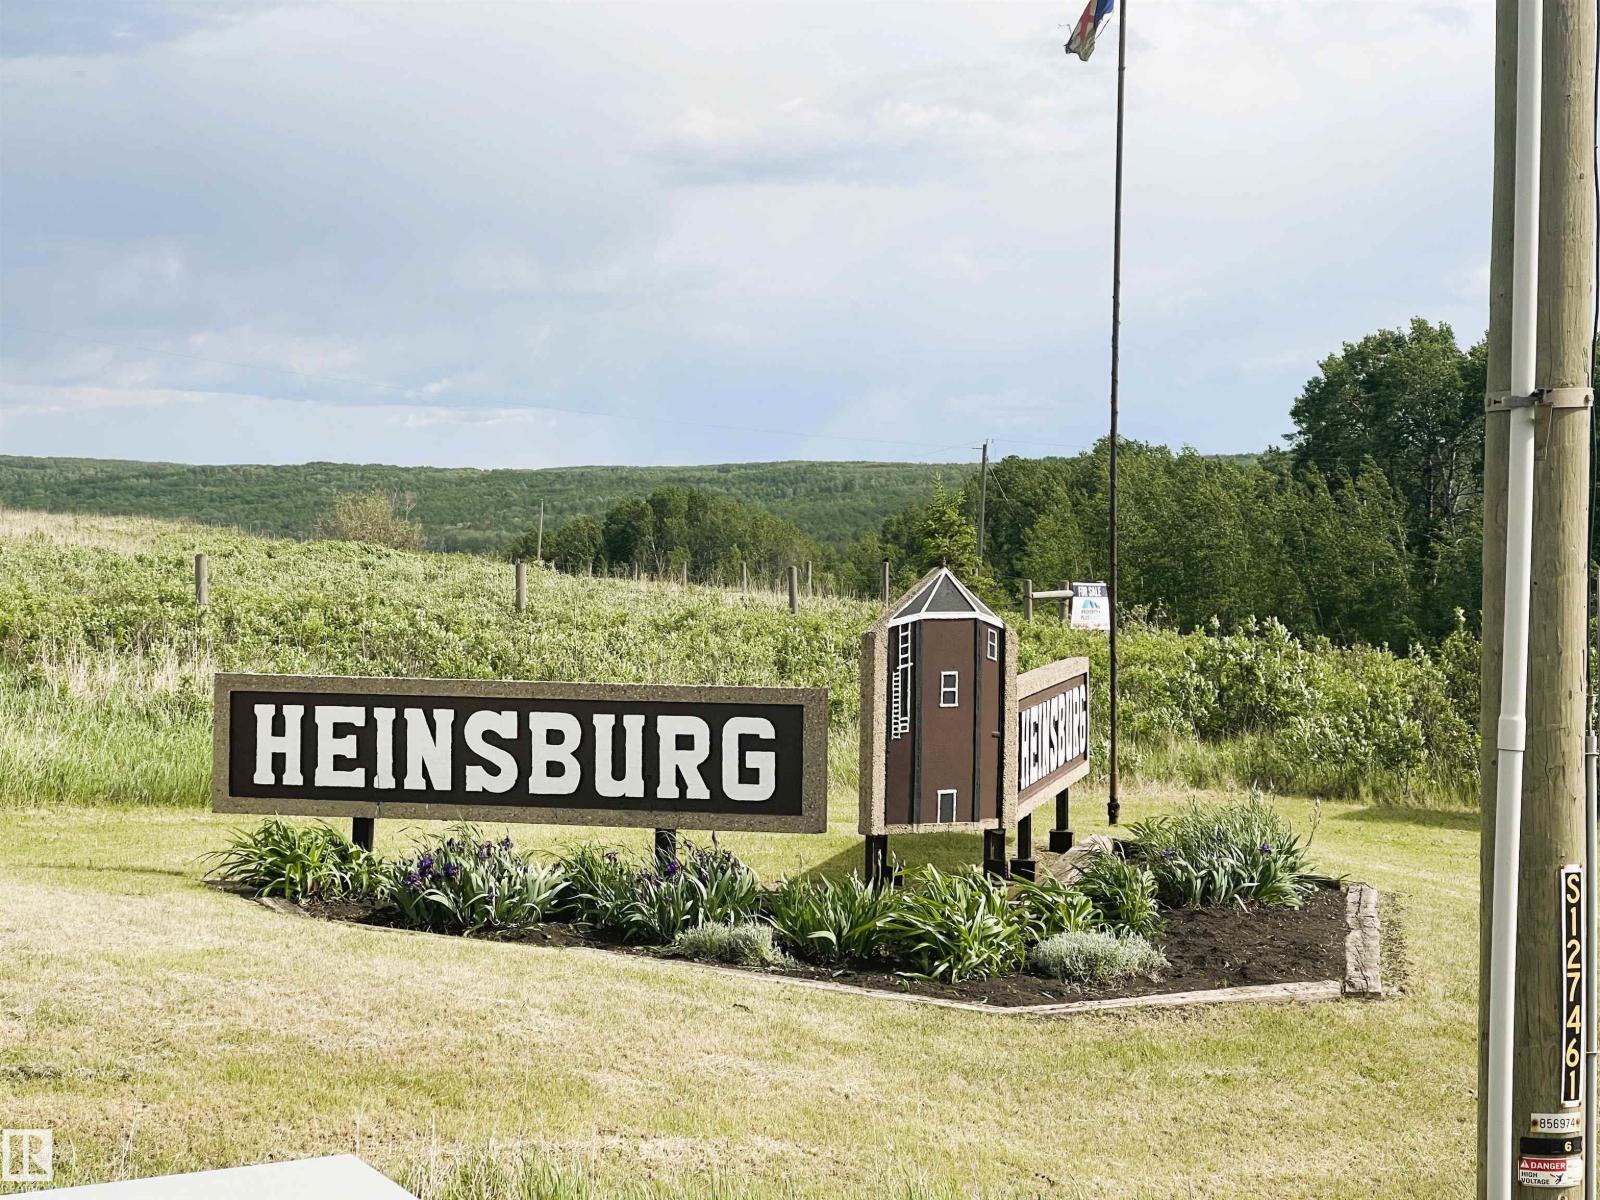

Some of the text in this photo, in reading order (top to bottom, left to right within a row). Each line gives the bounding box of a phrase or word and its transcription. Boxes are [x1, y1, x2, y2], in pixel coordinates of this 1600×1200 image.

[1078, 586, 1101, 597] FOR SALE
[1020, 684, 1087, 790] HEINSBURG
[252, 703, 777, 802] HEINSBURG
[1565, 873, 1581, 1100] S127461
[1539, 1118, 1575, 1129] 856974
[1564, 1141, 1572, 1152] 6
[1530, 1161, 1566, 1170] DANGER
